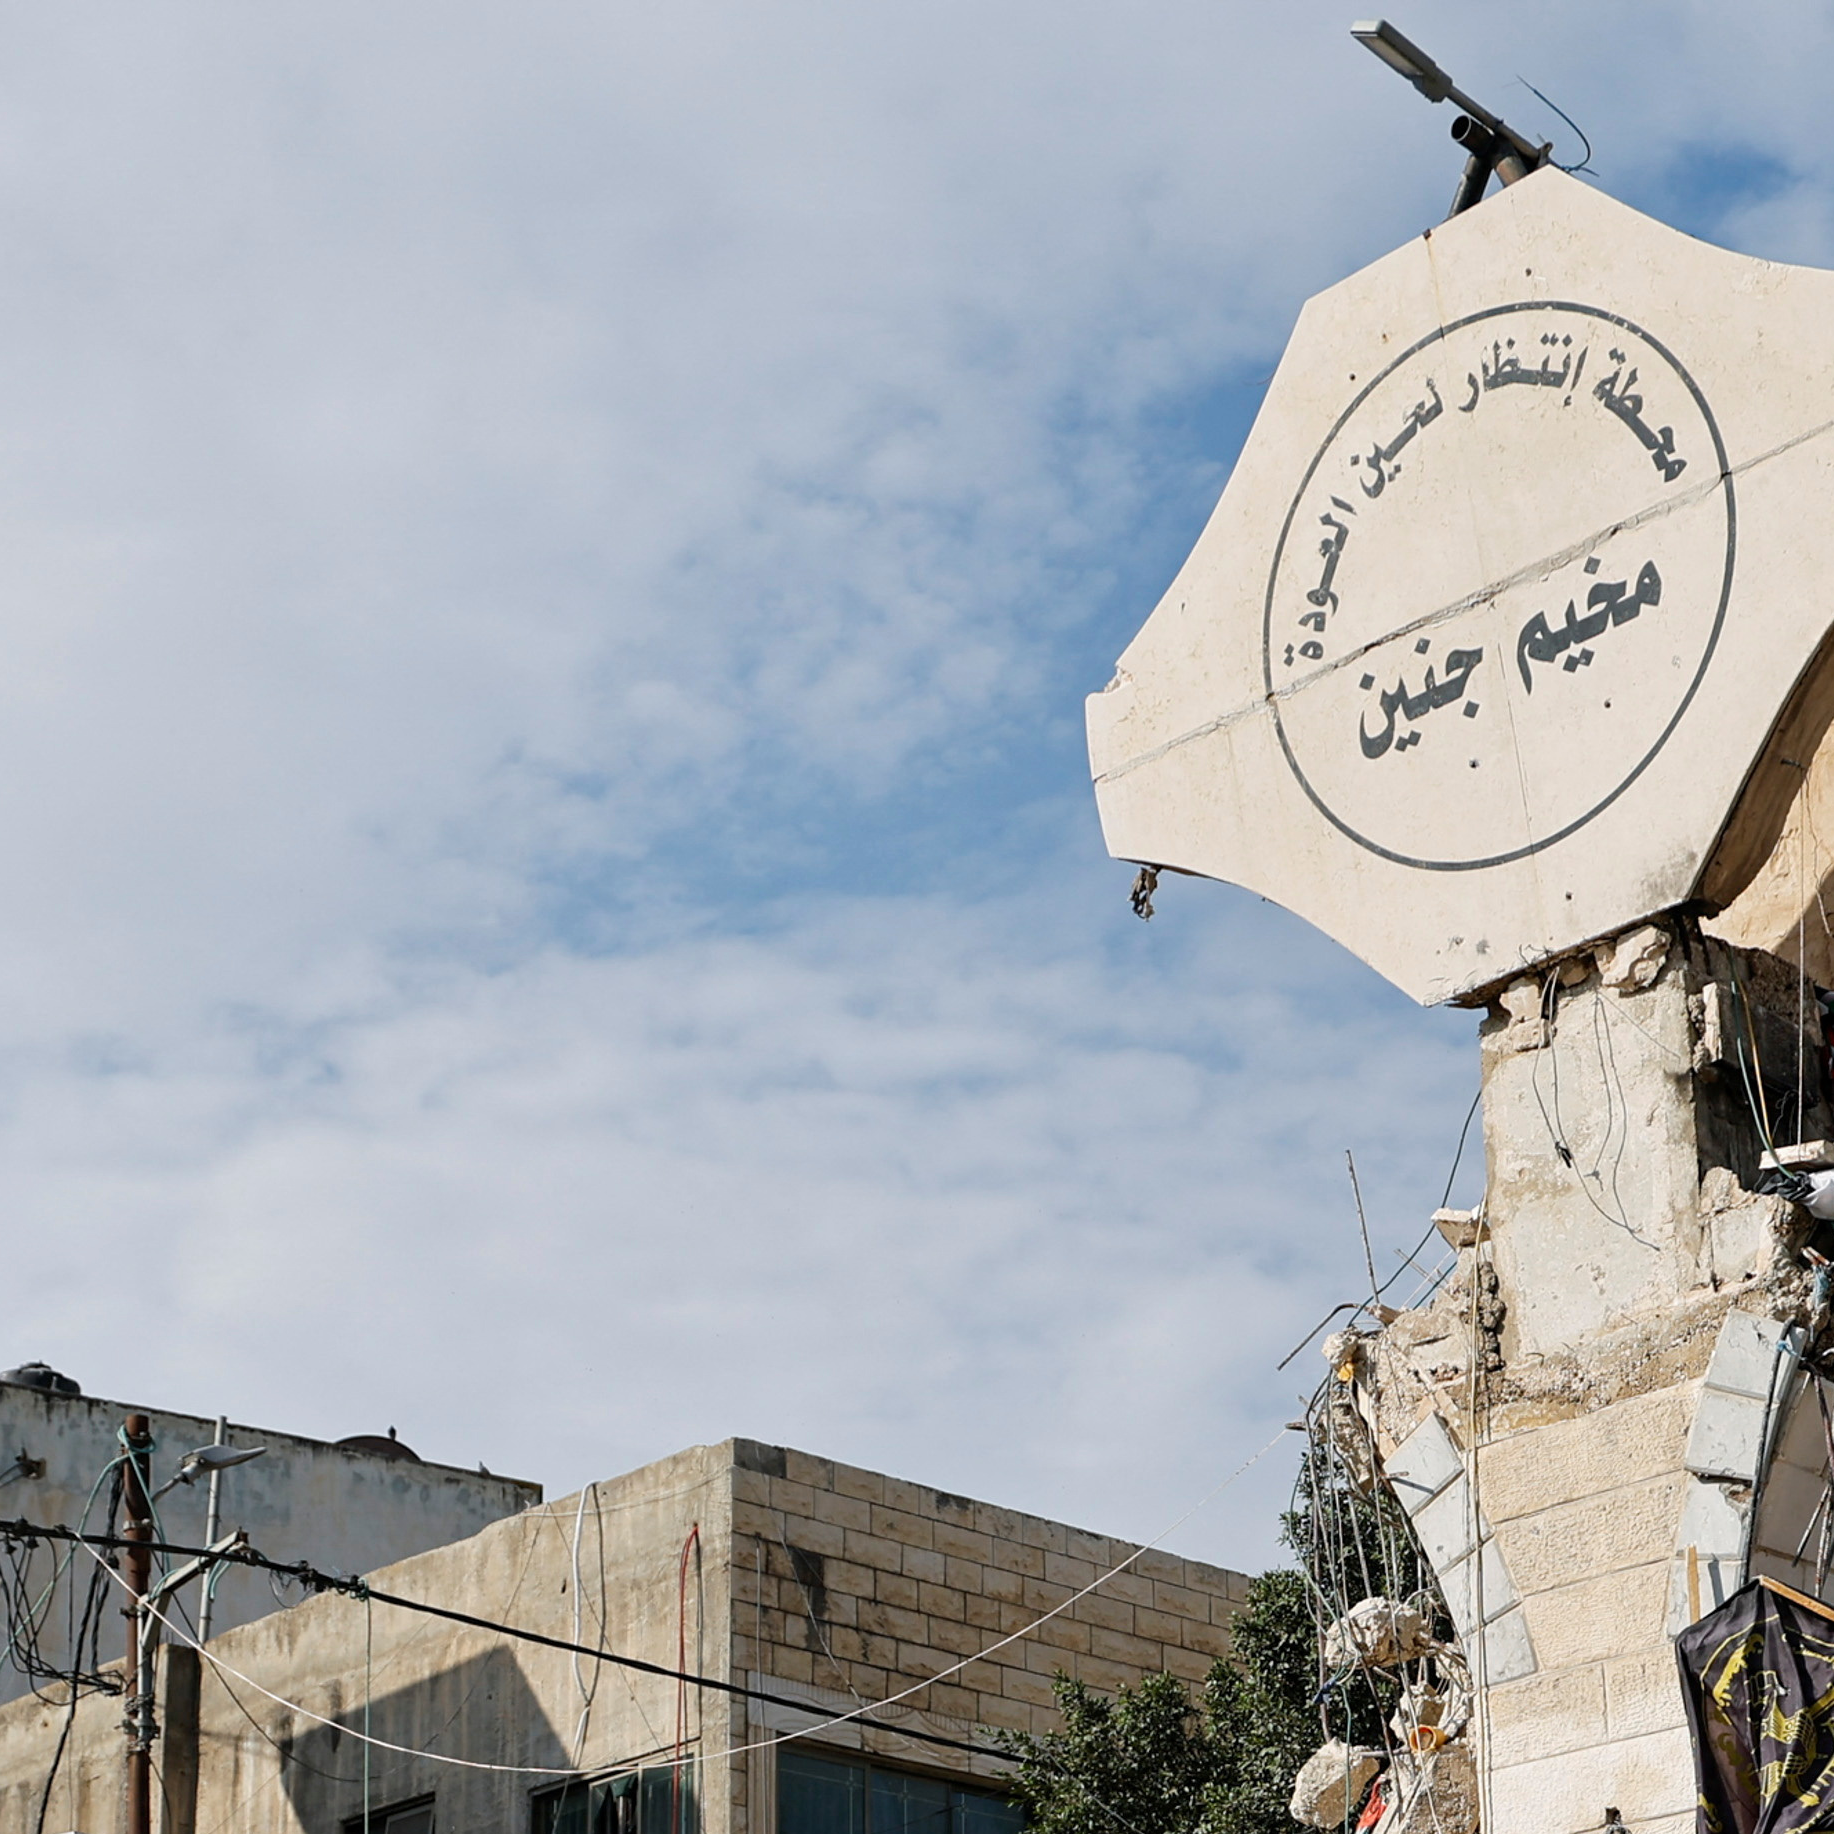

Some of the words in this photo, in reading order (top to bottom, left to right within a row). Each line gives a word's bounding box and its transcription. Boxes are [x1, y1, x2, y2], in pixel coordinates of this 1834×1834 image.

[1592, 347, 1687, 483] محطة
[1283, 495, 1358, 668] العودة
[1517, 556, 1663, 697] مخيم
[1359, 637, 1484, 760] جنين
